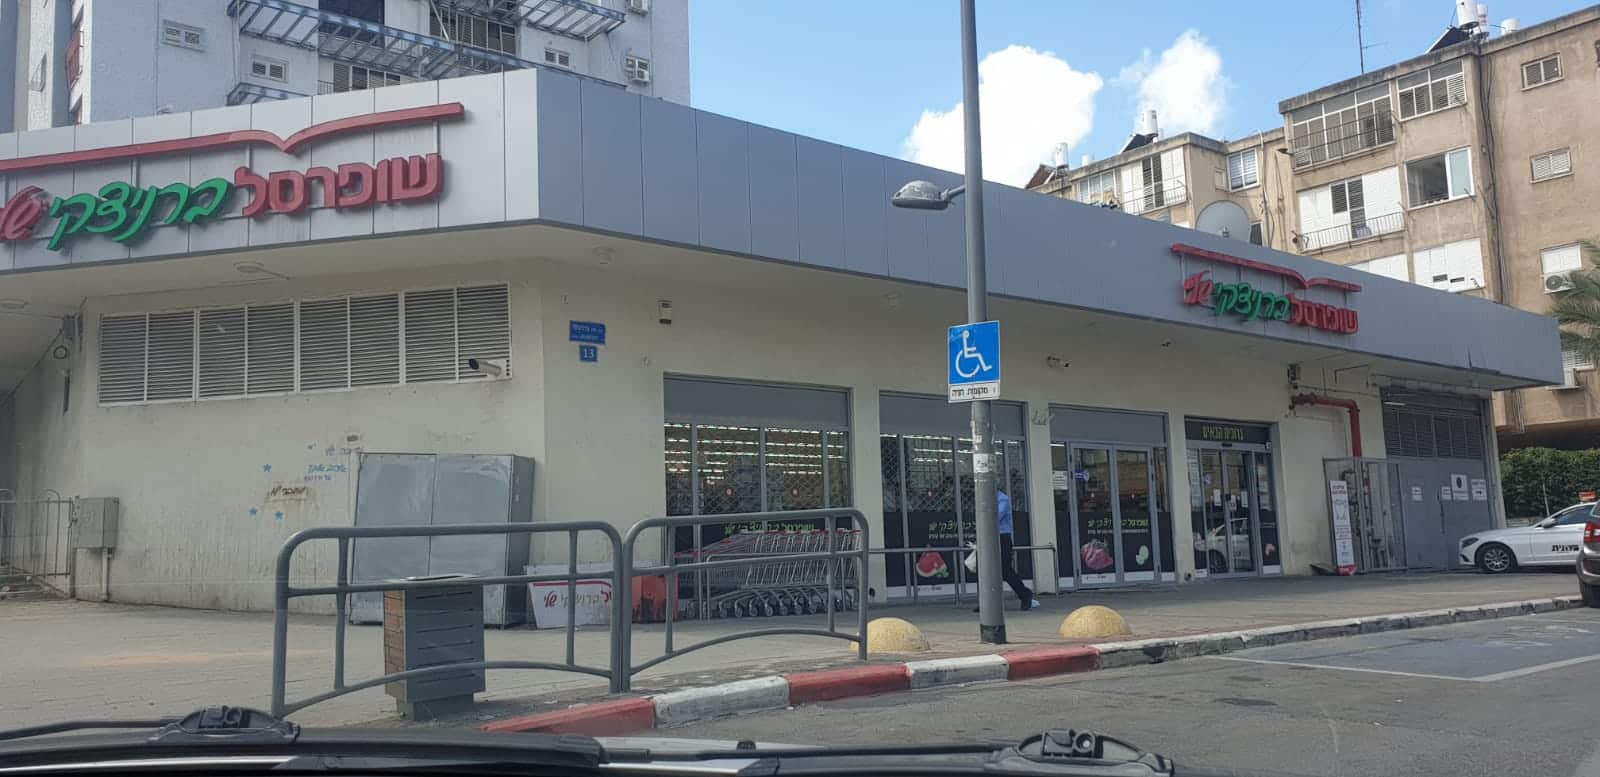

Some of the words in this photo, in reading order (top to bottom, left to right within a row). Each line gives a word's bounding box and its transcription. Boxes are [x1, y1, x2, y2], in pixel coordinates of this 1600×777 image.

[234, 152, 445, 218] שופרסל
[47, 177, 236, 252] ברניצקי
[1287, 292, 1360, 334] שופרסל
[583, 348, 594, 358] 13
